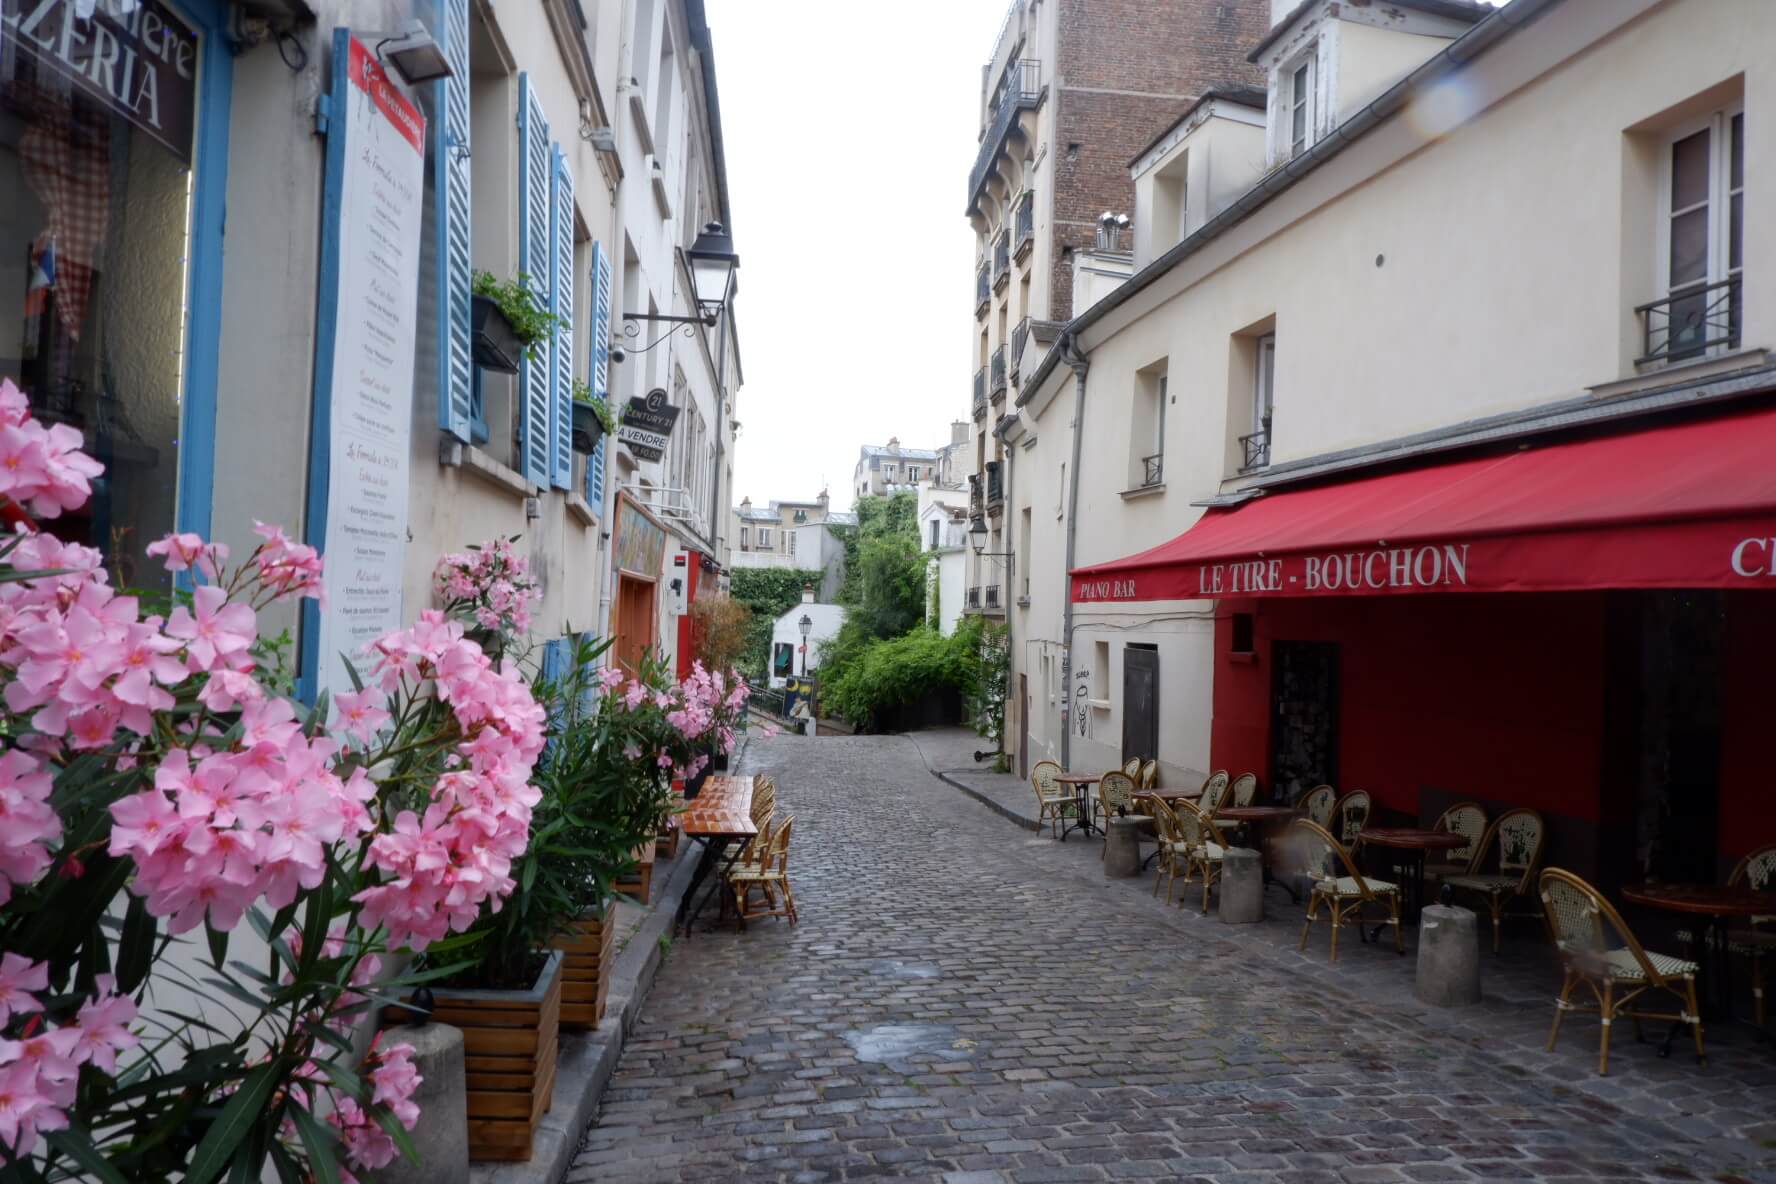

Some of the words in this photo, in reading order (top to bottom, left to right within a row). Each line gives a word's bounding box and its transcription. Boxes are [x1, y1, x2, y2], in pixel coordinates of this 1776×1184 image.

[0, 0, 162, 129] ZERIA
[651, 397, 662, 407] 21
[619, 427, 625, 437] A
[628, 430, 666, 448] VENDRE
[1199, 565, 1225, 594] LE
[1229, 559, 1283, 593] TIRE
[1303, 544, 1471, 591] BOUCHON
[1080, 582, 1110, 599] PIANO
[1113, 580, 1136, 598] BAR
